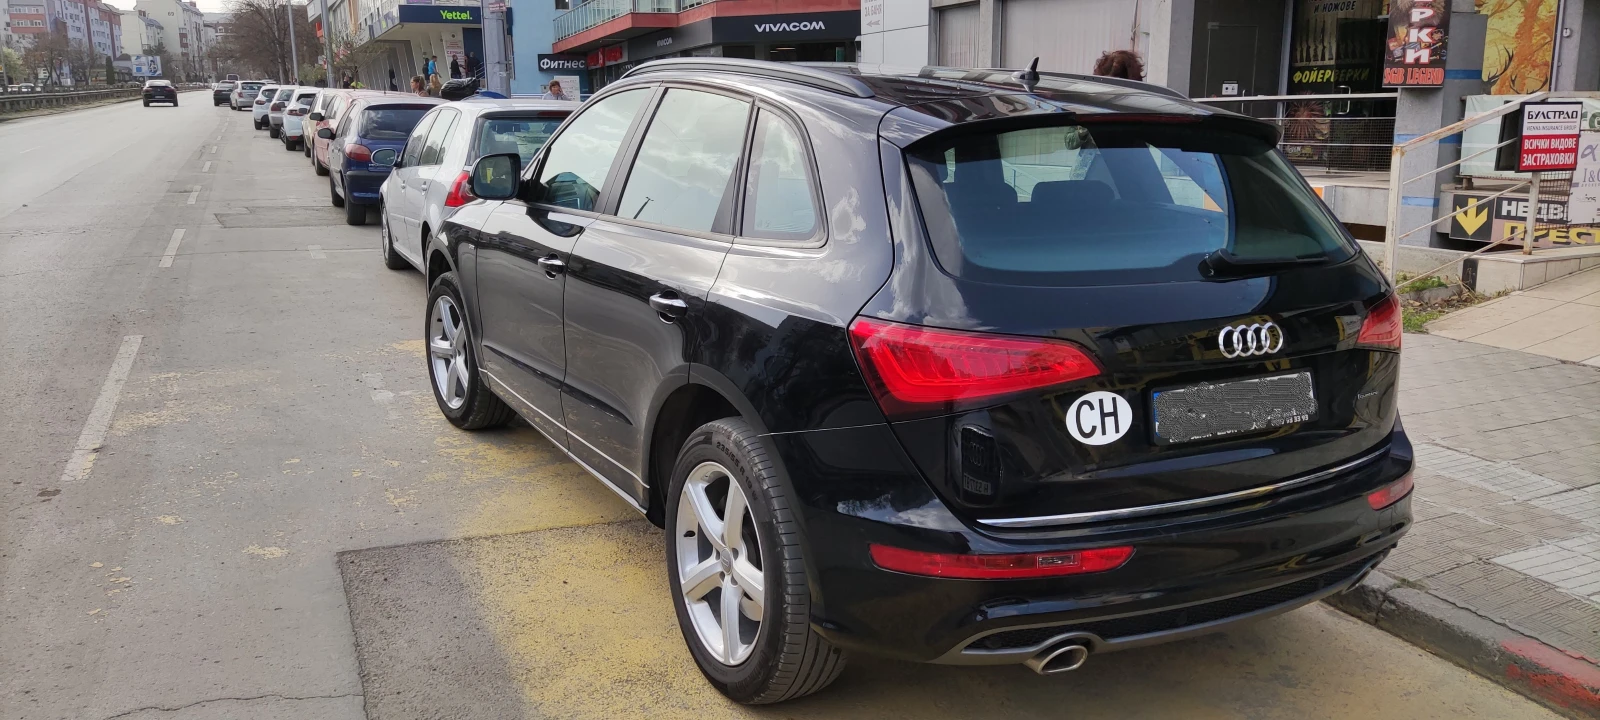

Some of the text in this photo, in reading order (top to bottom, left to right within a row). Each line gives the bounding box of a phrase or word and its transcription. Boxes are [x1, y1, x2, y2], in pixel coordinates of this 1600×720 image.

[1322, 1, 1357, 13] НОЖОВЕ
[440, 10, 473, 20] Yettel.
[754, 20, 826, 33] VIVACOM
[1404, 0, 1434, 63] РКИ
[540, 58, 585, 69] Фитнес
[1292, 67, 1370, 84] ФОЙЕРВЕРКИ
[1384, 67, 1444, 85] SGB LEGEND
[1527, 110, 1578, 120] БУЛСТРАД
[1524, 137, 1577, 150] ВСИЧКИ ВИДОВЕ
[1522, 152, 1575, 166] ЗАСТРАХОВКИ
[1501, 199, 1568, 221] НЕДВ
[1075, 396, 1120, 439] CH
[716, 441, 740, 467] 235/55
